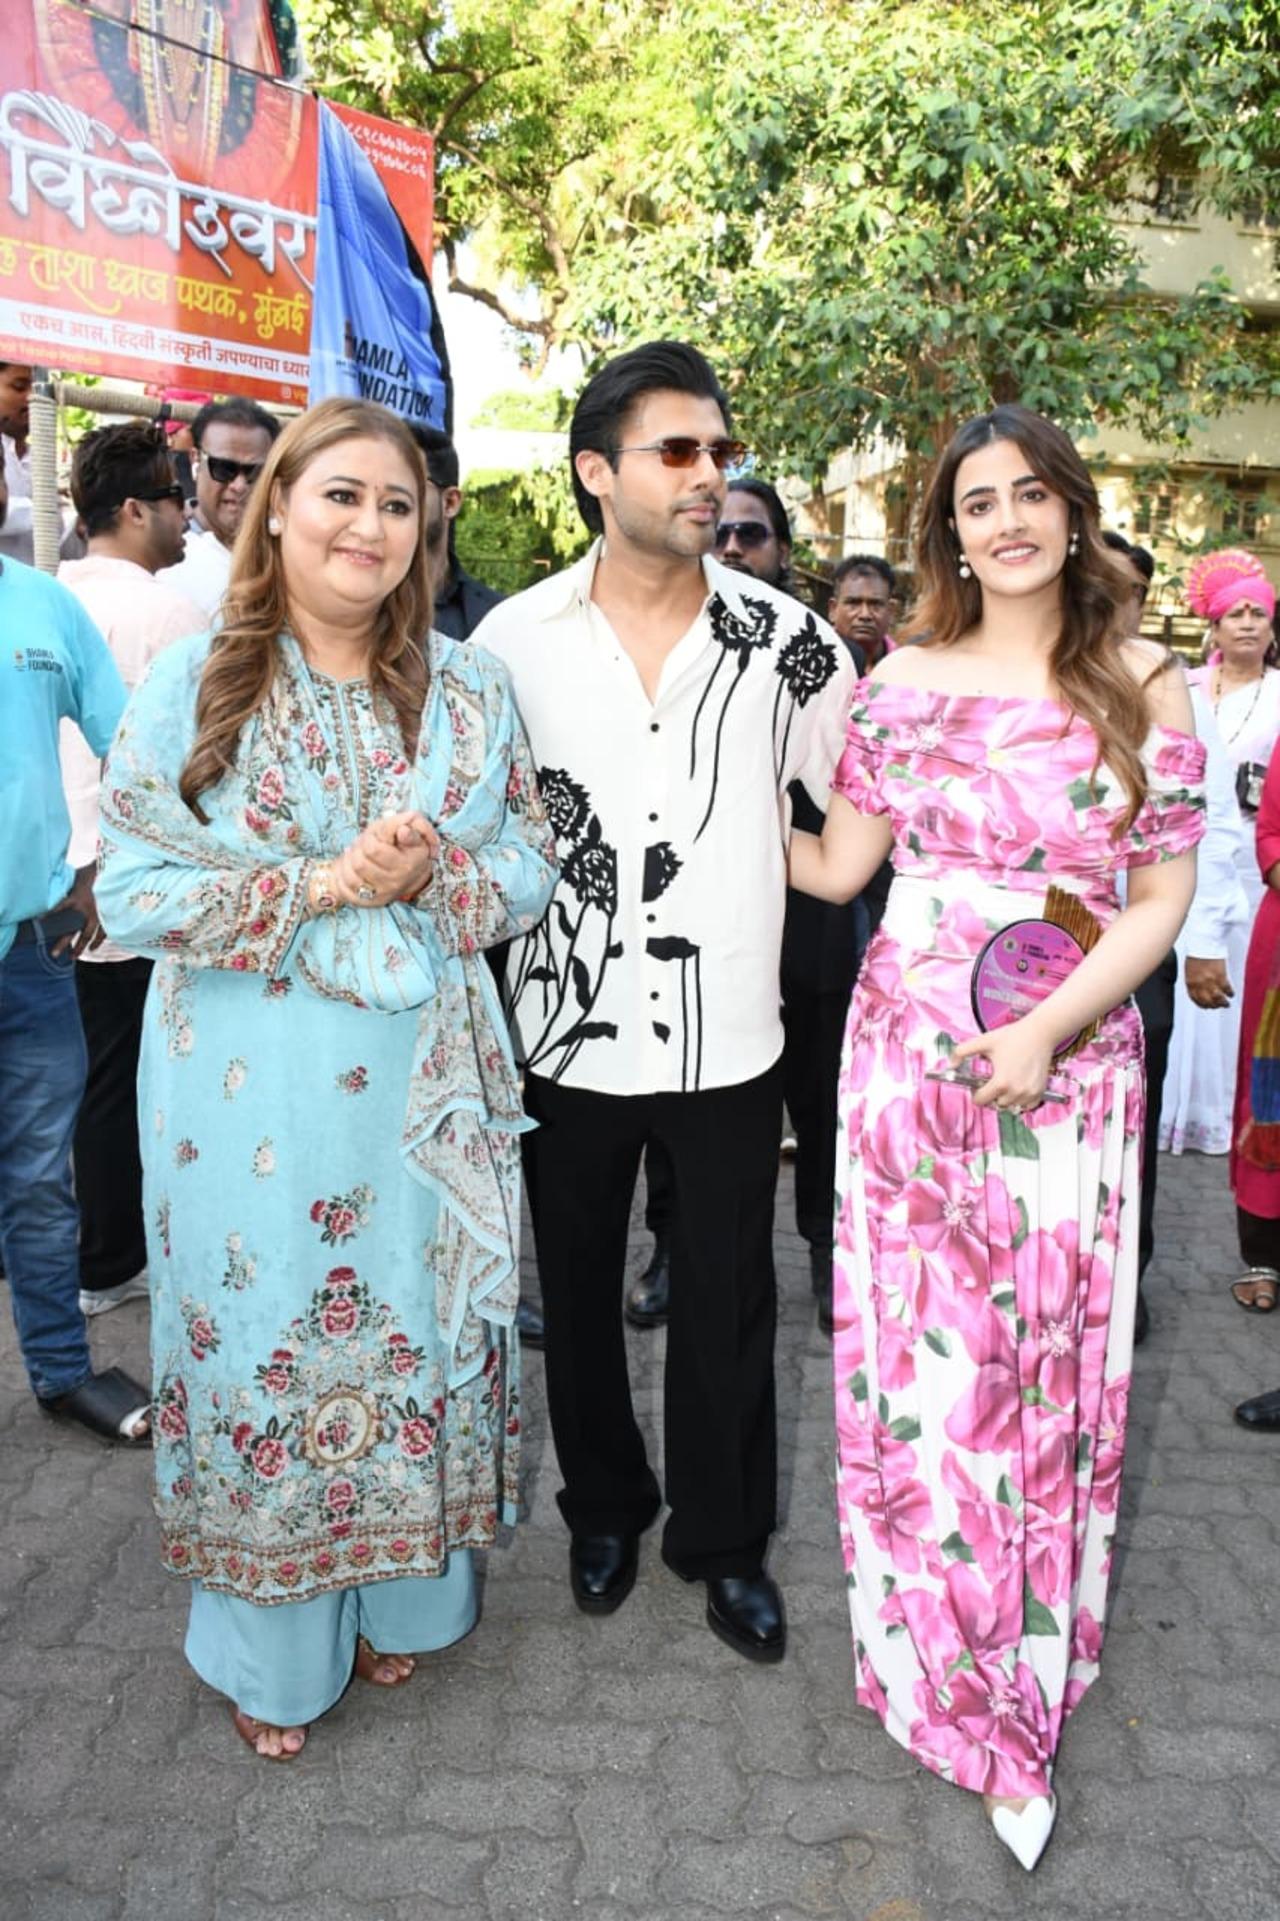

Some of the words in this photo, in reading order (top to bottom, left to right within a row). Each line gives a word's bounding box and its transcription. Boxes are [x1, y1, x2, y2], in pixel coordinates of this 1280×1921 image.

[23, 242, 123, 315] ताशा
[175, 275, 247, 324] पथक,
[253, 286, 309, 339] मुंबई
[216, 347, 280, 373] जपण्याचा
